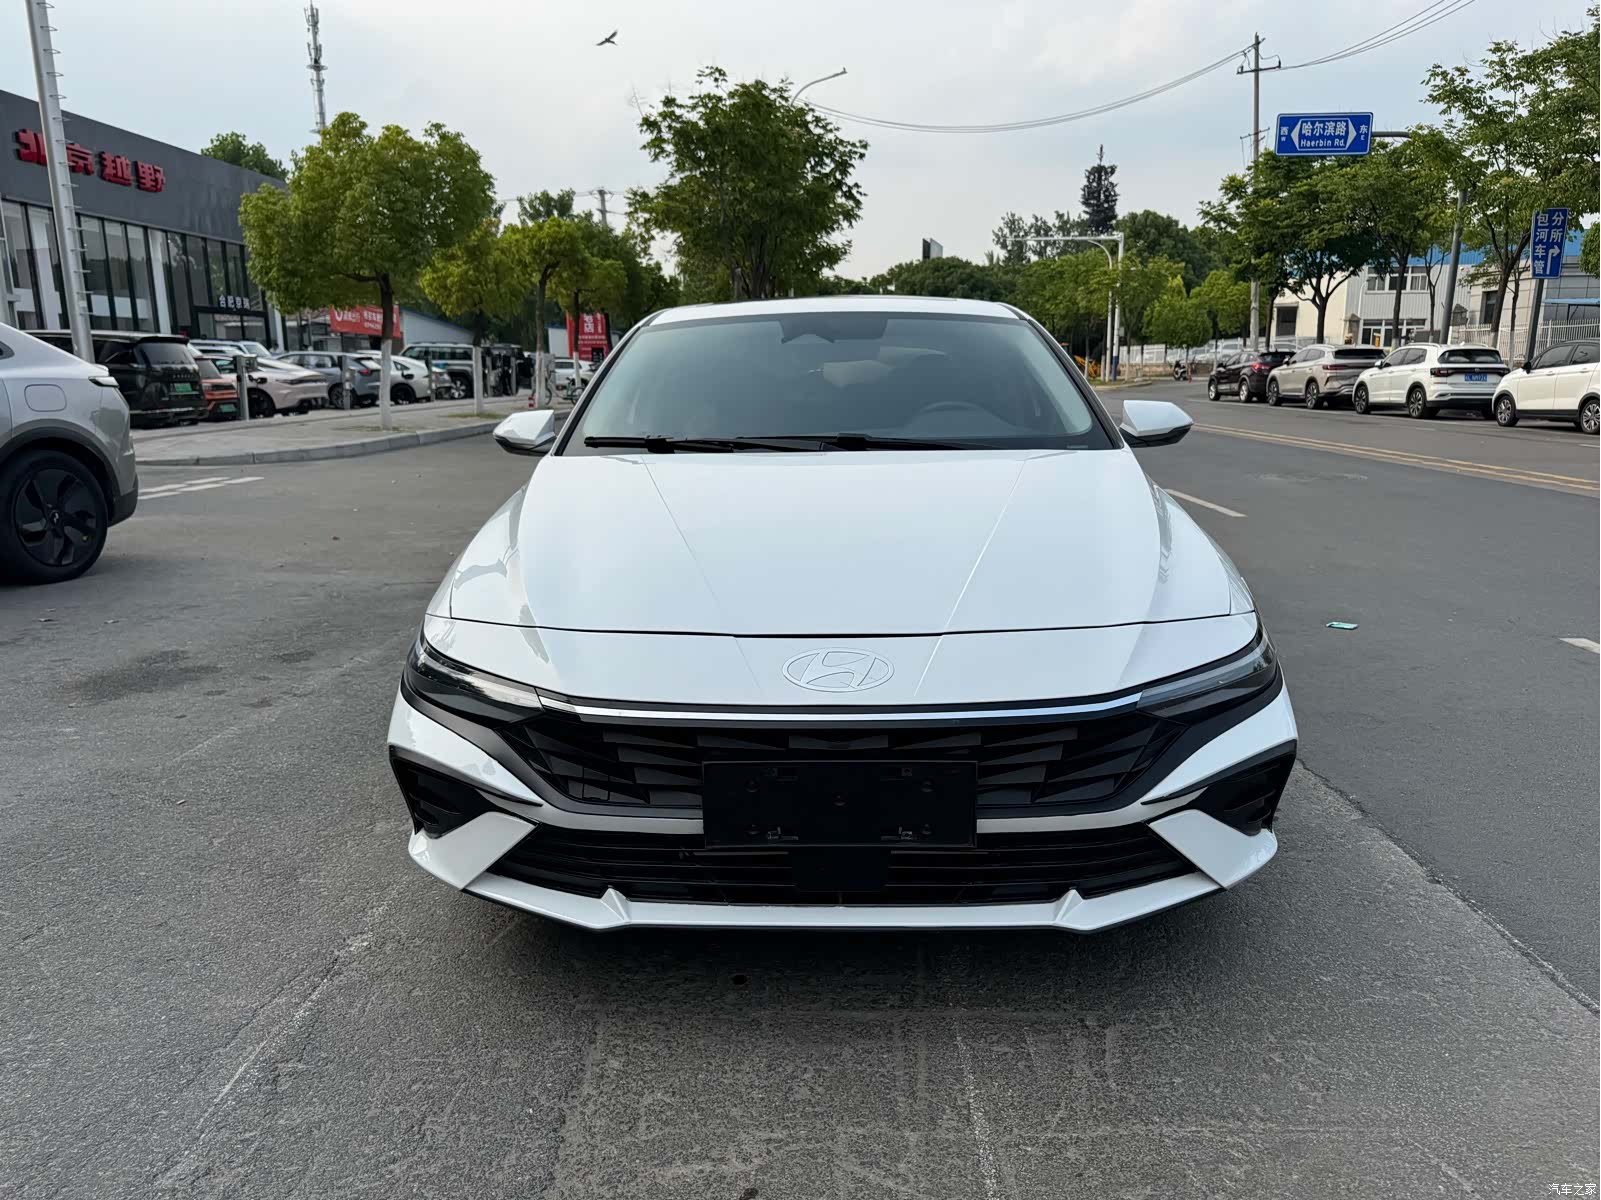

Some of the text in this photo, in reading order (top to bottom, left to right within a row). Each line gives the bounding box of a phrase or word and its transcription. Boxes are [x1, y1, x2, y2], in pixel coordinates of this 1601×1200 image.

[1281, 126, 1289, 135] 西
[1301, 121, 1347, 136] 哈尔滨路
[1359, 124, 1368, 134] 东
[1300, 139, 1345, 147] Haerbin Rd.
[17, 128, 165, 193] 北京越野
[1550, 212, 1564, 242] 分所
[1534, 212, 1549, 275] 包河车管
